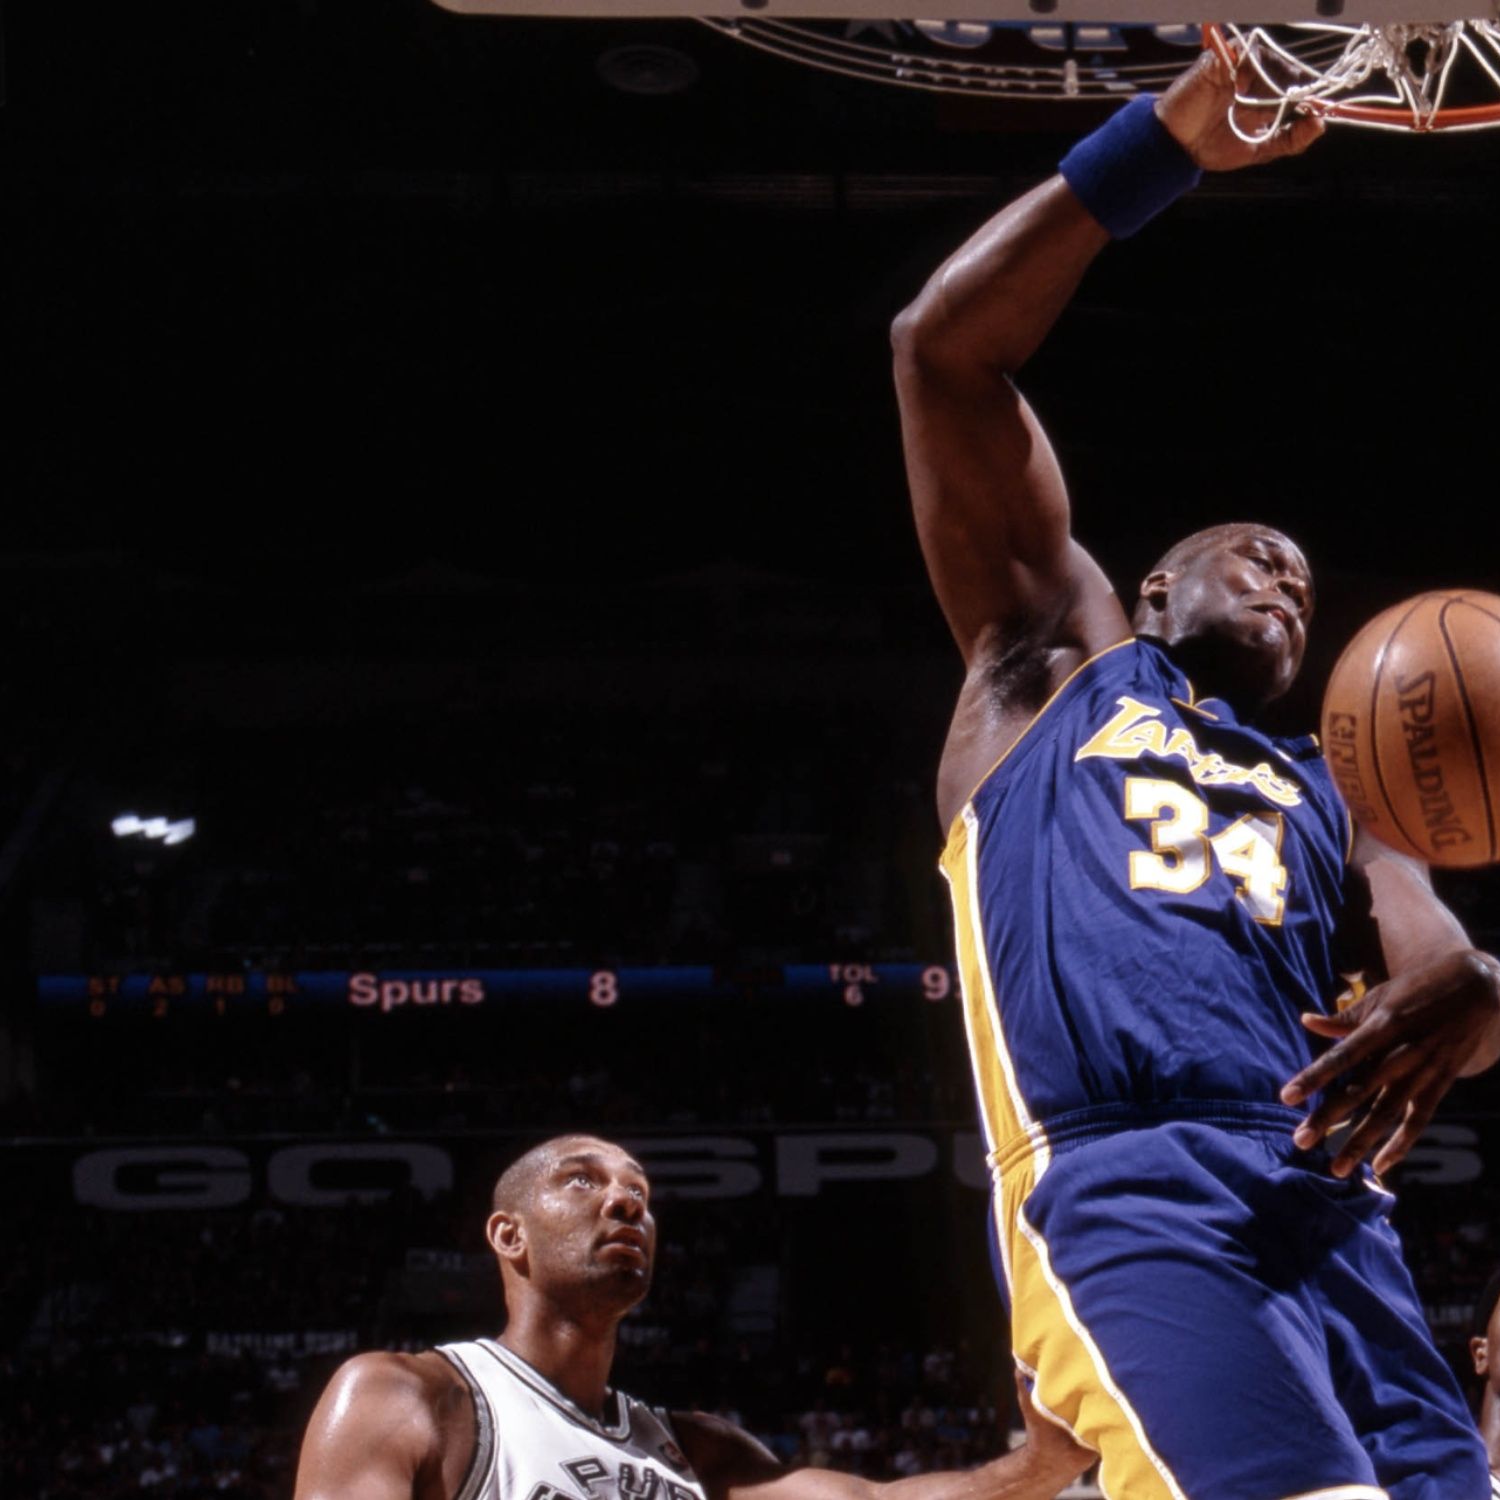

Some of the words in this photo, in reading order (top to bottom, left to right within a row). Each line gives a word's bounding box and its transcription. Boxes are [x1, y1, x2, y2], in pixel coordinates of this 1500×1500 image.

[1394, 670, 1473, 852] SPALDING
[1124, 776, 1292, 927] 34
[349, 972, 484, 1013] Spurs
[590, 970, 618, 1007] 8
[829, 963, 877, 983] TOL
[844, 984, 864, 1007] 6
[71, 1143, 454, 1211] GO
